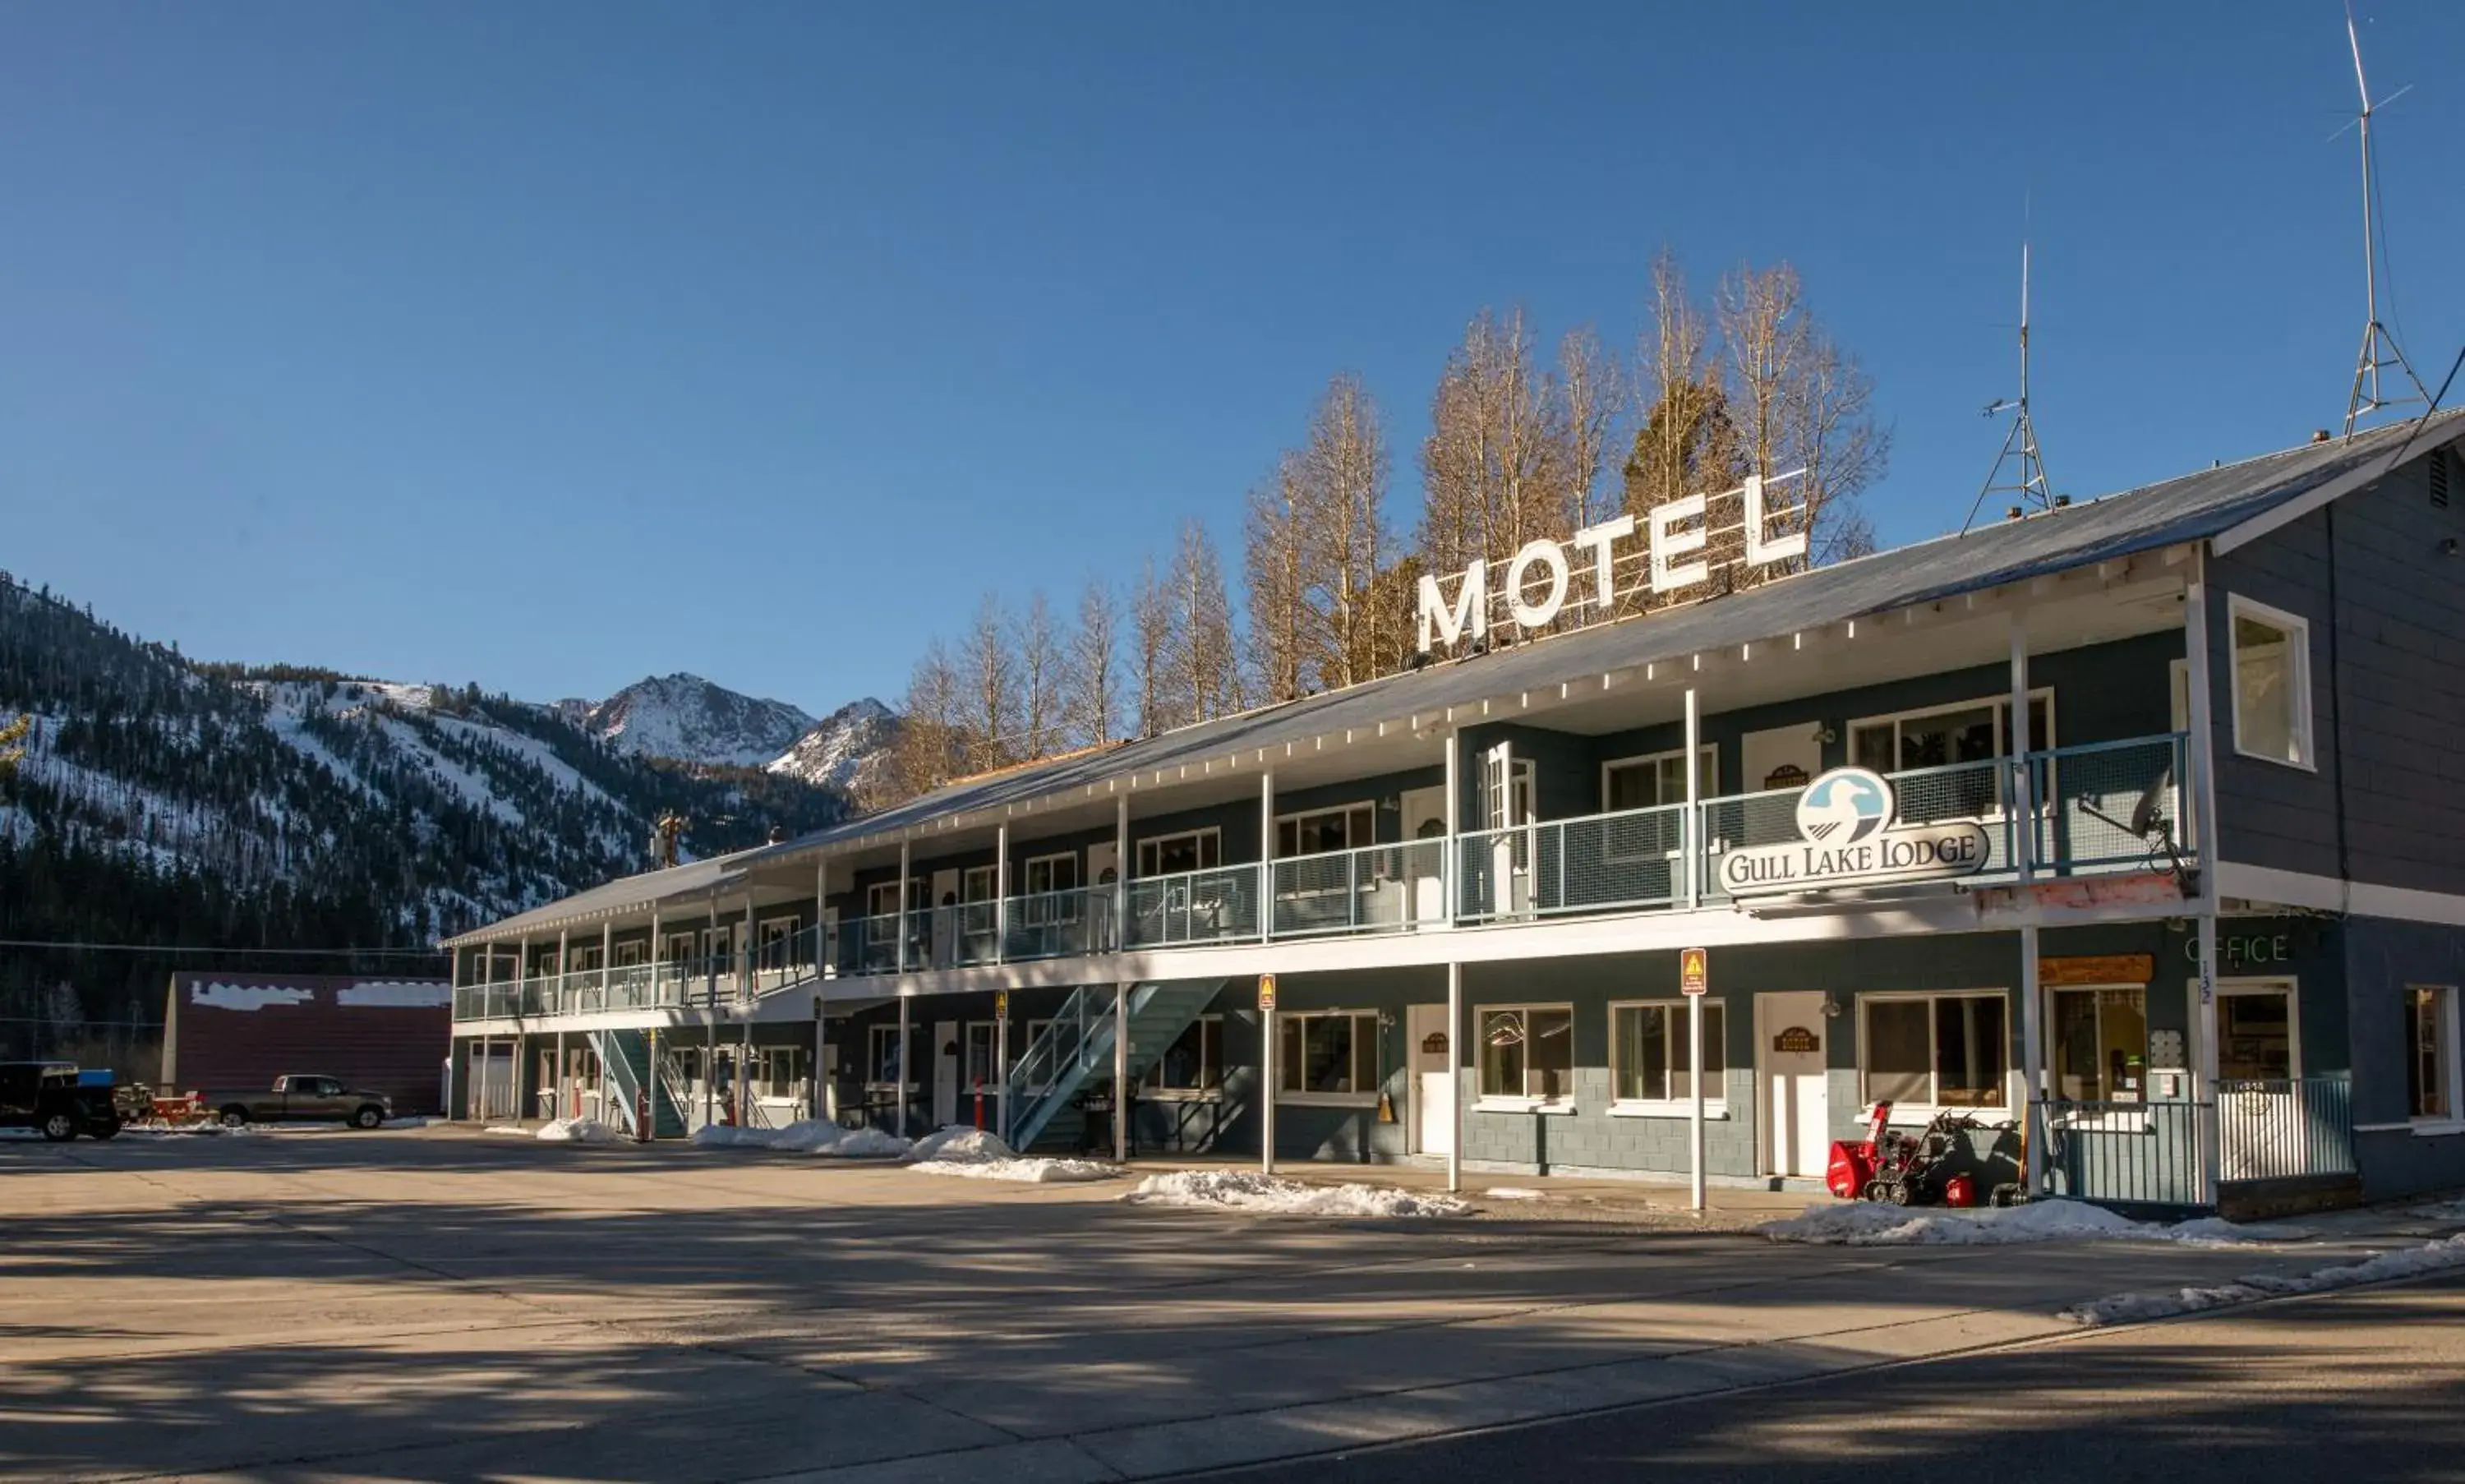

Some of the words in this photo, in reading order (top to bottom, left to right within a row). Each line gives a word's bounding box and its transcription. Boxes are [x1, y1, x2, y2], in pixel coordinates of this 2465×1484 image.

[1417, 474, 1807, 654] MOTEL
[1727, 854, 1796, 883] GULL
[1803, 846, 1873, 877] LAKE
[1879, 835, 1977, 869] LODGE
